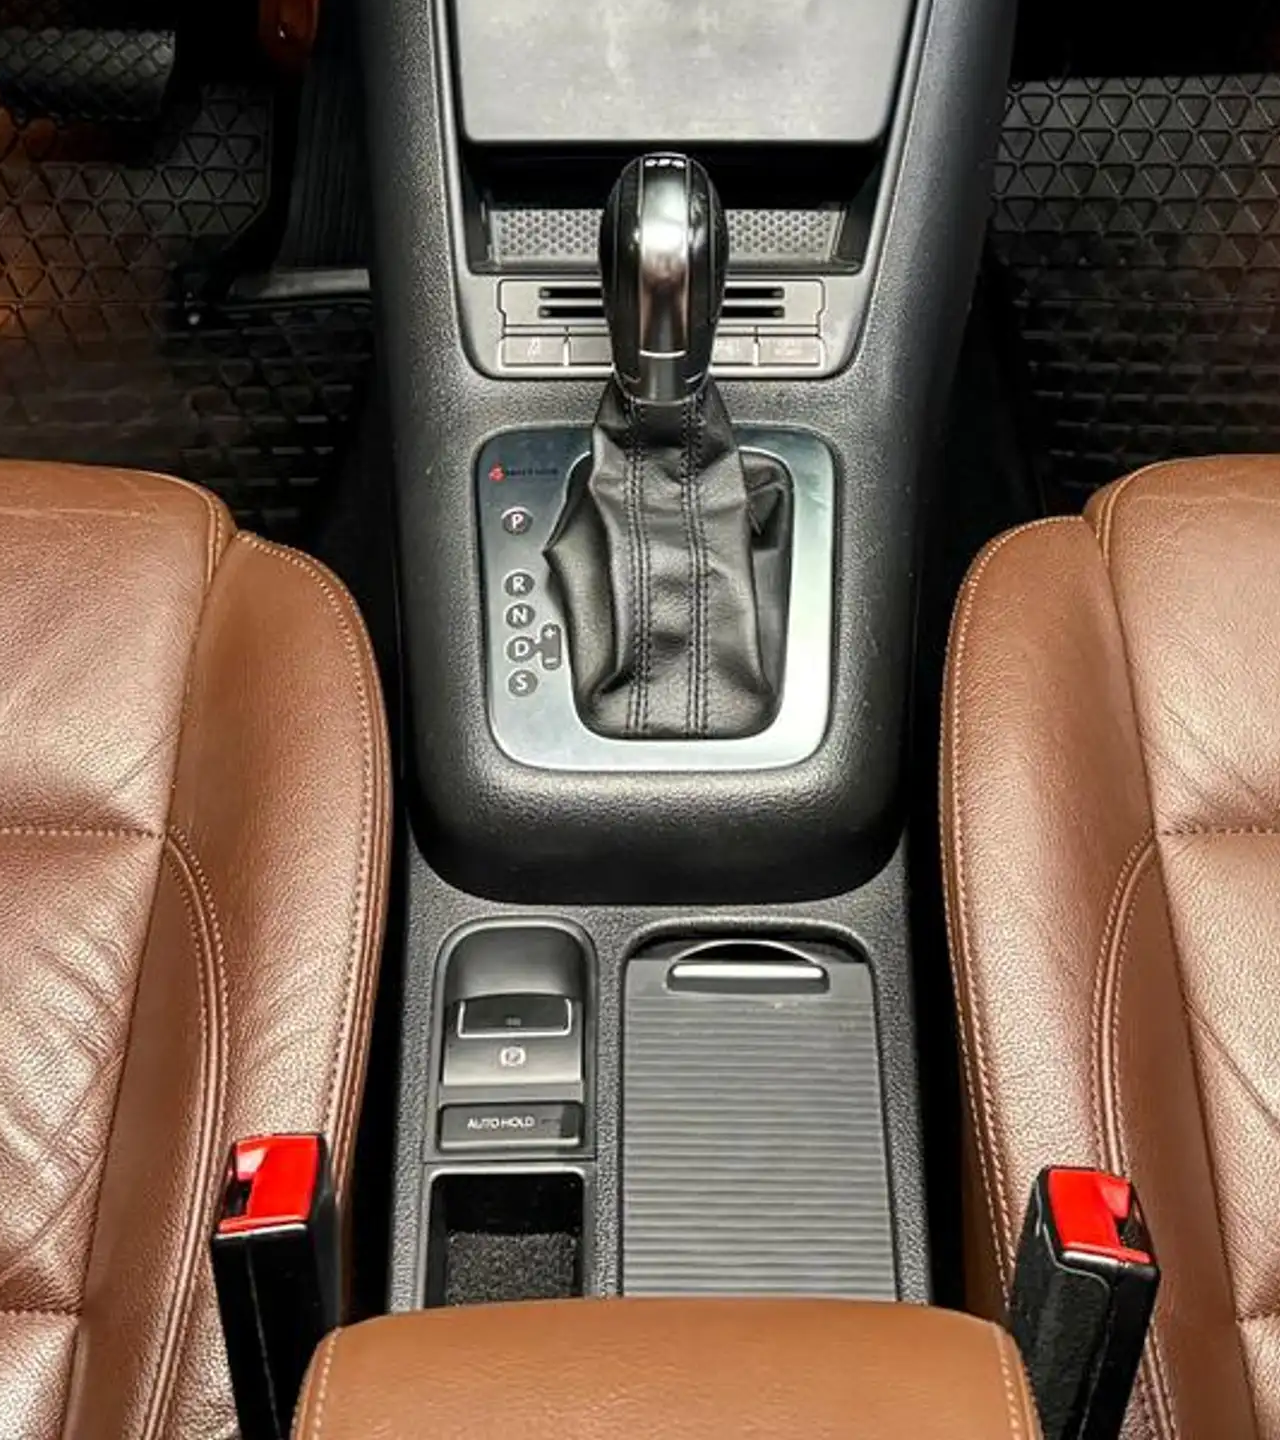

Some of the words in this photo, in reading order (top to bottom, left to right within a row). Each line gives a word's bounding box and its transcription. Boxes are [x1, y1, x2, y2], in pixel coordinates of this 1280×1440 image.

[511, 514, 525, 530] P
[512, 575, 526, 594] R
[512, 607, 529, 626] N
[514, 639, 530, 657] D
[515, 673, 529, 691] S
[466, 1117, 500, 1130] AUTO
[501, 1116, 536, 1128] HOLD
